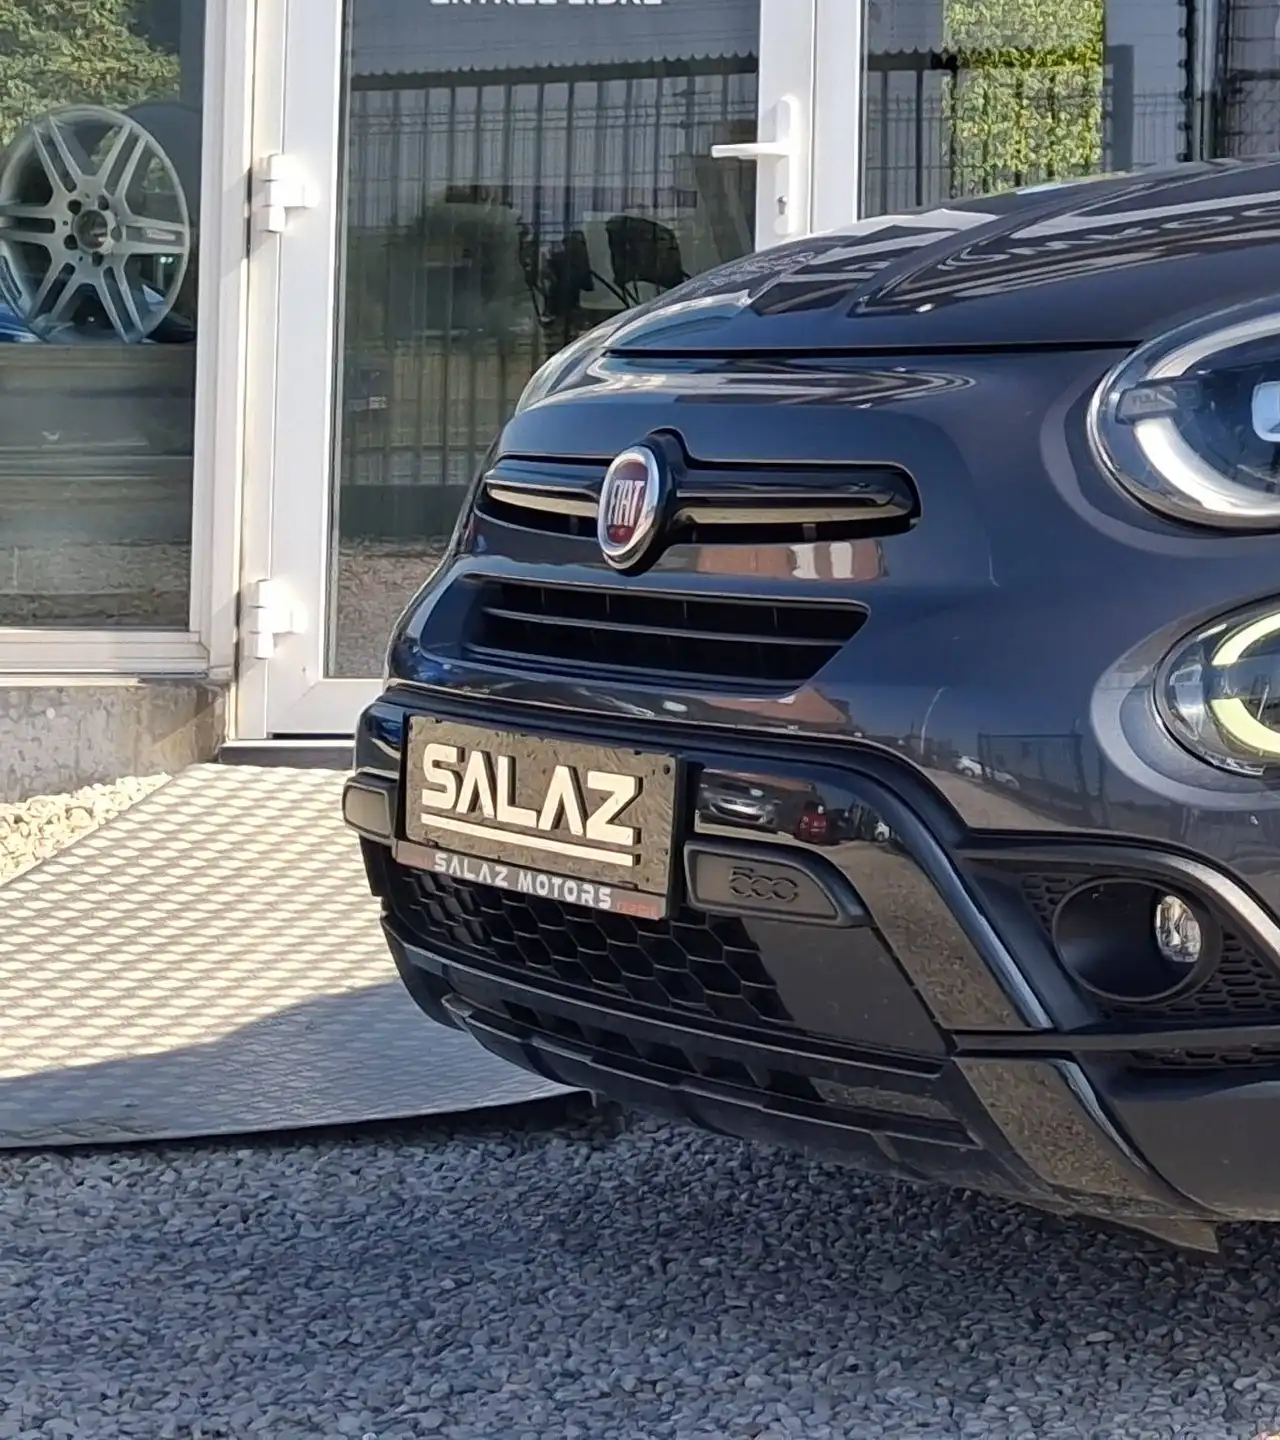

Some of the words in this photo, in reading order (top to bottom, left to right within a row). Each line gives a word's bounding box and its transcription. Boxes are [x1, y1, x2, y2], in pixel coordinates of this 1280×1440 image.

[607, 479, 646, 527] FIAT
[420, 743, 640, 847] SALAZ
[432, 852, 509, 888] SALAZ
[516, 870, 613, 910] MOTORS
